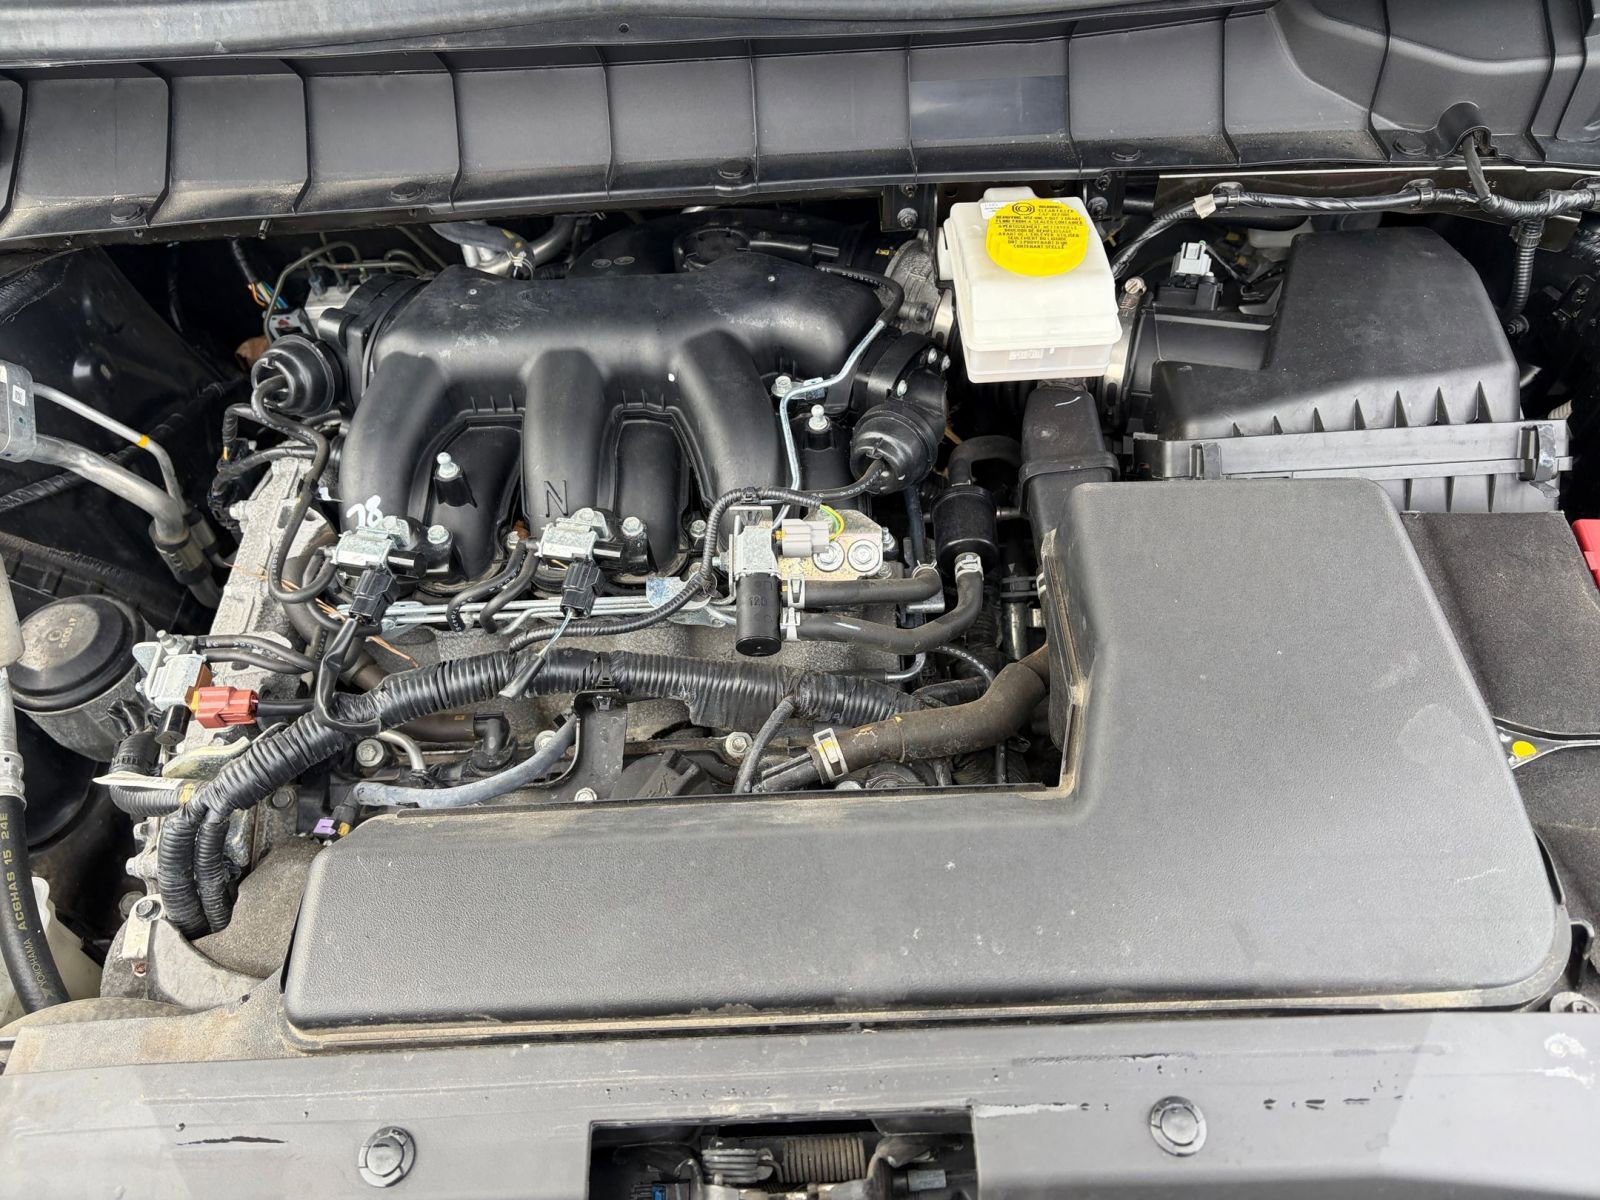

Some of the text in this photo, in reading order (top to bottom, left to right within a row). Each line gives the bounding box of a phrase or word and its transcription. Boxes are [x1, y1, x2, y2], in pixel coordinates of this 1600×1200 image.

[543, 479, 569, 518] N
[0, 812, 10, 840] 24E
[3, 849, 12, 865] 15
[24, 938, 48, 987] YOKOHAMA
